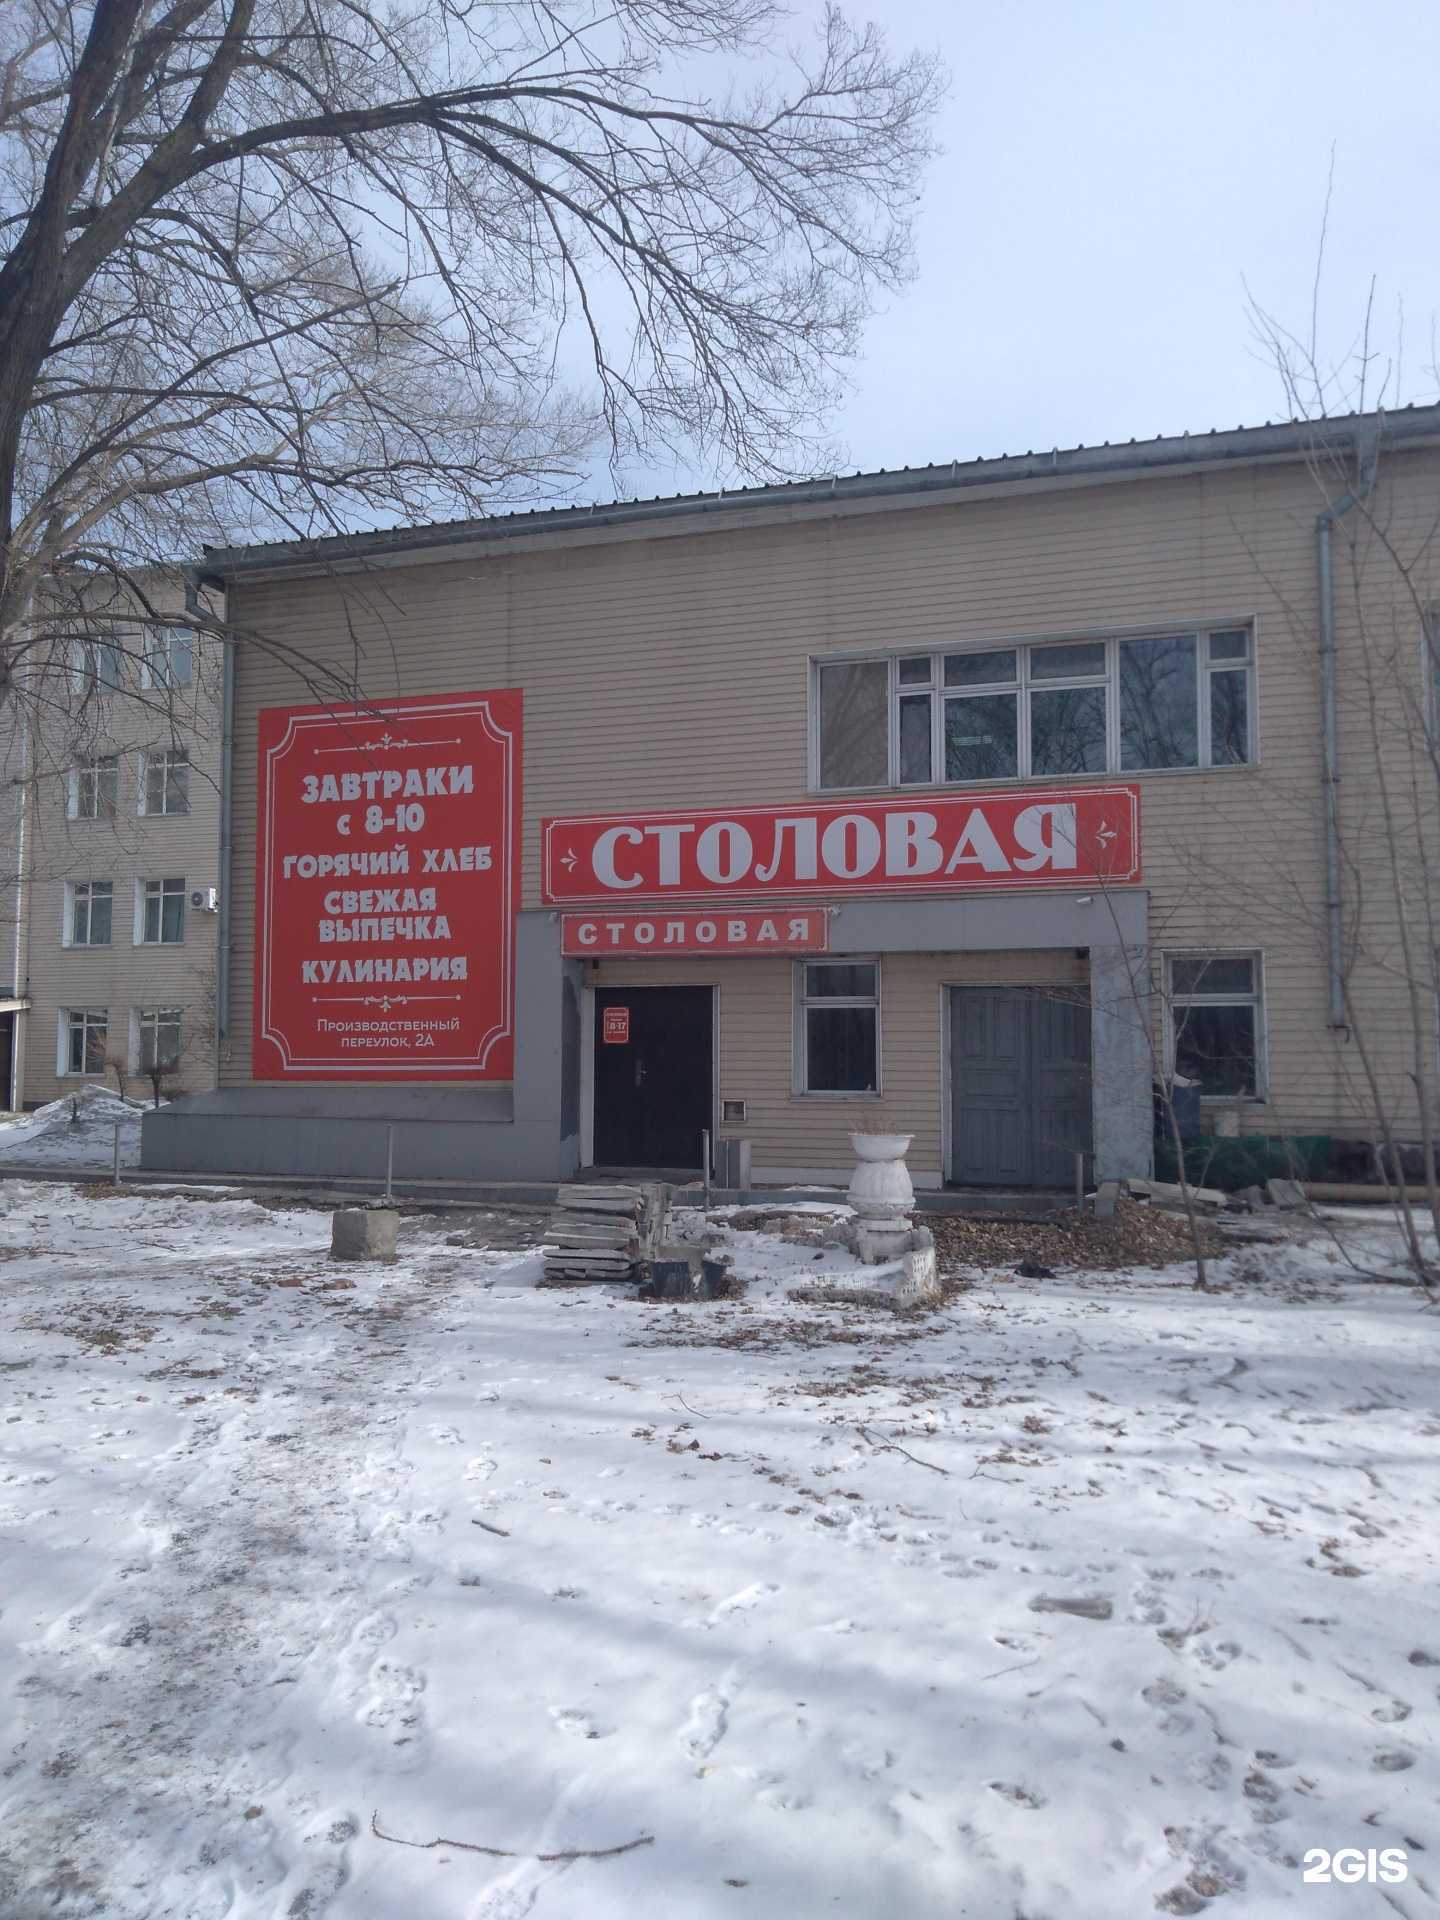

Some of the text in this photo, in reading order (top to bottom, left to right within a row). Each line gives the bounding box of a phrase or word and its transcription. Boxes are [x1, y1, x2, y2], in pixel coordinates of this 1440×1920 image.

[301, 764, 474, 805] ЗАВТРАКИ
[364, 802, 426, 835] 8-10
[283, 843, 493, 879] ГОРЯЧИЙ ХЛЕБ
[591, 802, 1078, 890] СТОЛОВАЯ
[324, 887, 438, 916] СВЕЖАЯ
[318, 915, 452, 943] ВЫПЕЧКА
[577, 916, 811, 946] СТОЛОВАЯ
[302, 956, 469, 985] КУЛИНАРИЯ
[414, 1033, 436, 1048] 2А
